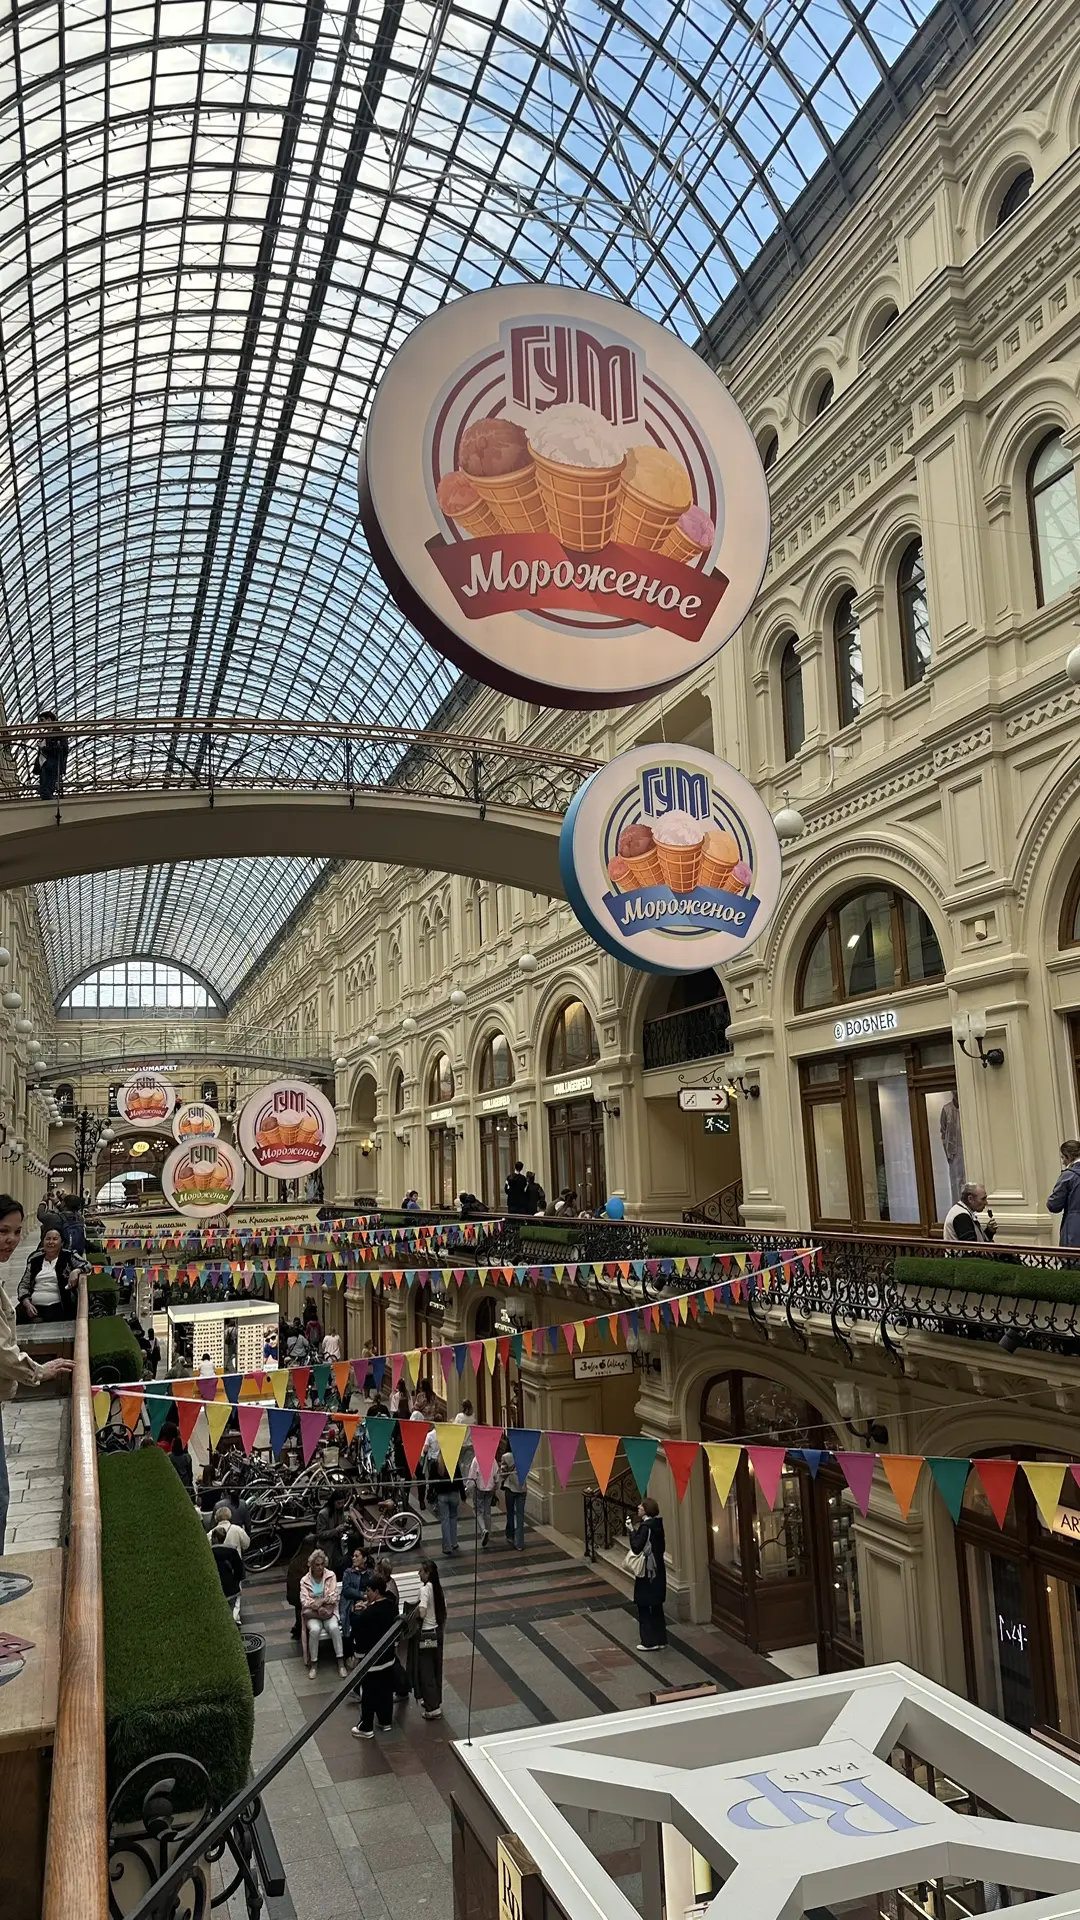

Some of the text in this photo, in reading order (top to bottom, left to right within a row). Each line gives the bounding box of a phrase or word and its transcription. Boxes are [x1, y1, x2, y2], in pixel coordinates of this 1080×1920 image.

[510, 326, 639, 426] ГУМ
[461, 550, 702, 618] Мороженое
[642, 766, 711, 821] ГУМ
[620, 896, 746, 925] Мороженое
[846, 1013, 895, 1036] BOGNER
[273, 1089, 306, 1113] ГУМ
[190, 1145, 218, 1165] ГУМ
[260, 1146, 320, 1161] Мороженое
[178, 1190, 230, 1204] Мороженое
[249, 1215, 279, 1226] Красной
[1060, 1513, 1080, 1534] AR
[782, 1761, 861, 1783] PARIS
